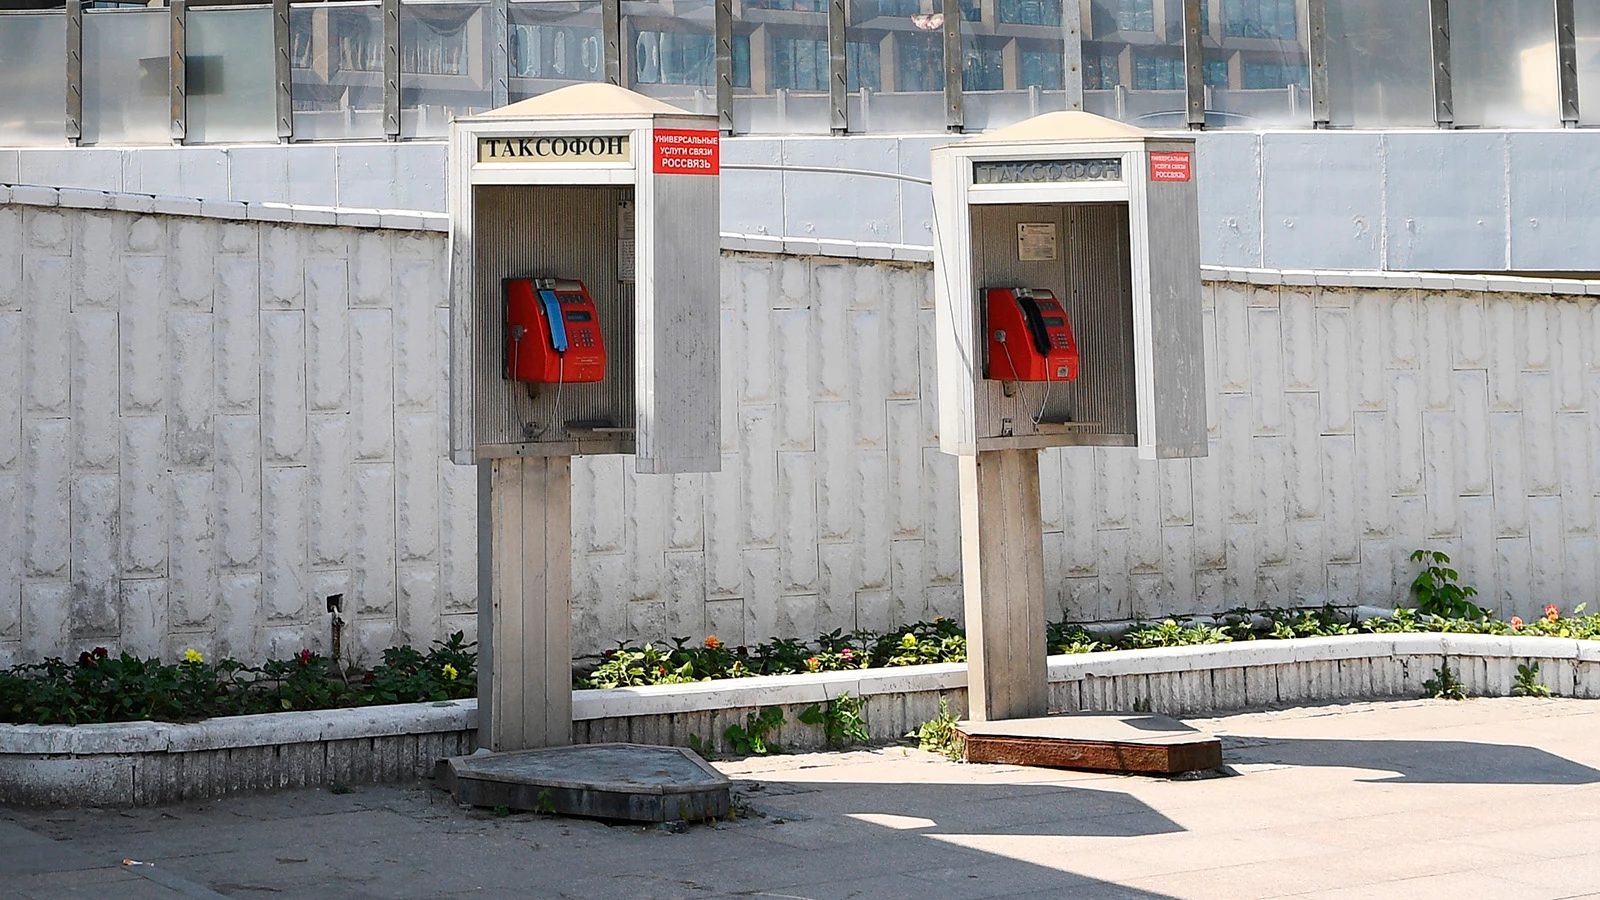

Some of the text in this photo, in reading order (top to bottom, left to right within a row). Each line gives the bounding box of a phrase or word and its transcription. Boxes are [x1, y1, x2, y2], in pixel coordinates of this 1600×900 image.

[654, 135, 718, 145] УНИВЕРСАЛЬНЫЕ
[486, 137, 623, 157] ТАКСОФОН
[660, 147, 713, 156] УСЛУГИ СВЯЗИ
[661, 158, 711, 169] РОССВЯЗЬ
[980, 161, 1120, 182] ТАКСОФОН
